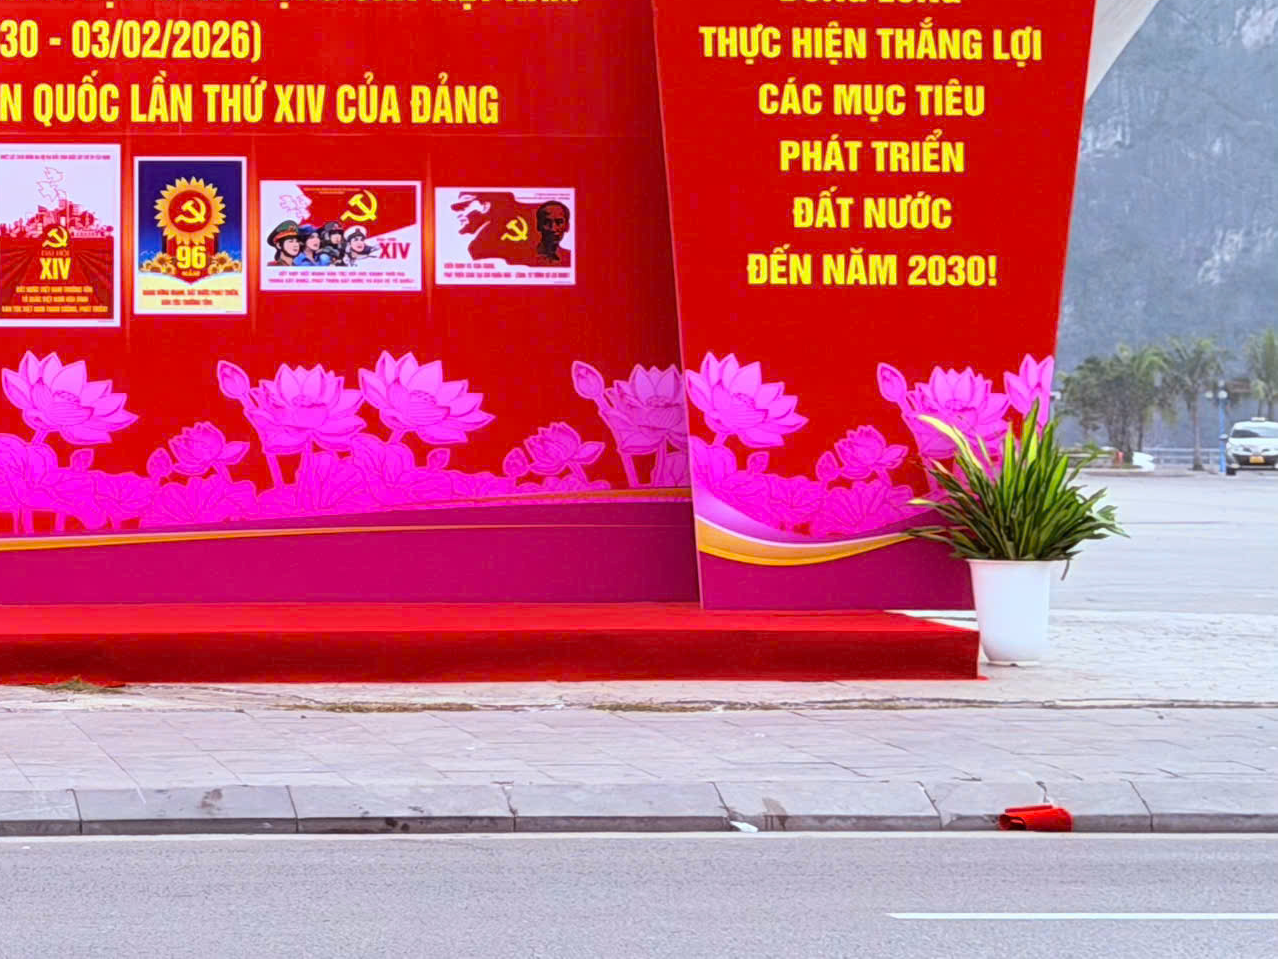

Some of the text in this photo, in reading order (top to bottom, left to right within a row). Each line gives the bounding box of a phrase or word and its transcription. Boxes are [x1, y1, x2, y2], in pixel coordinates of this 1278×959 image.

[49, 37, 62, 46] -
[71, 18, 262, 63] 03/02/2026)
[698, 16, 1042, 68] THỰC HIỆN THẮNG LỢI
[33, 69, 120, 127] QUỐC
[130, 70, 193, 123] LẦN
[202, 75, 268, 124] THỨ
[273, 84, 326, 124] XIV
[336, 71, 402, 124] CỦA
[409, 72, 499, 125] ĐẢNG
[758, 76, 985, 123] CÁC MỤC TIÊU
[780, 128, 965, 173] PHÁT TRIỂN
[792, 186, 952, 230] ĐẤT NƯỚC
[39, 257, 72, 280] XIV
[176, 245, 207, 269] 96
[378, 242, 411, 260] XIV
[746, 243, 997, 287] ĐẾN NĂM 2030!
